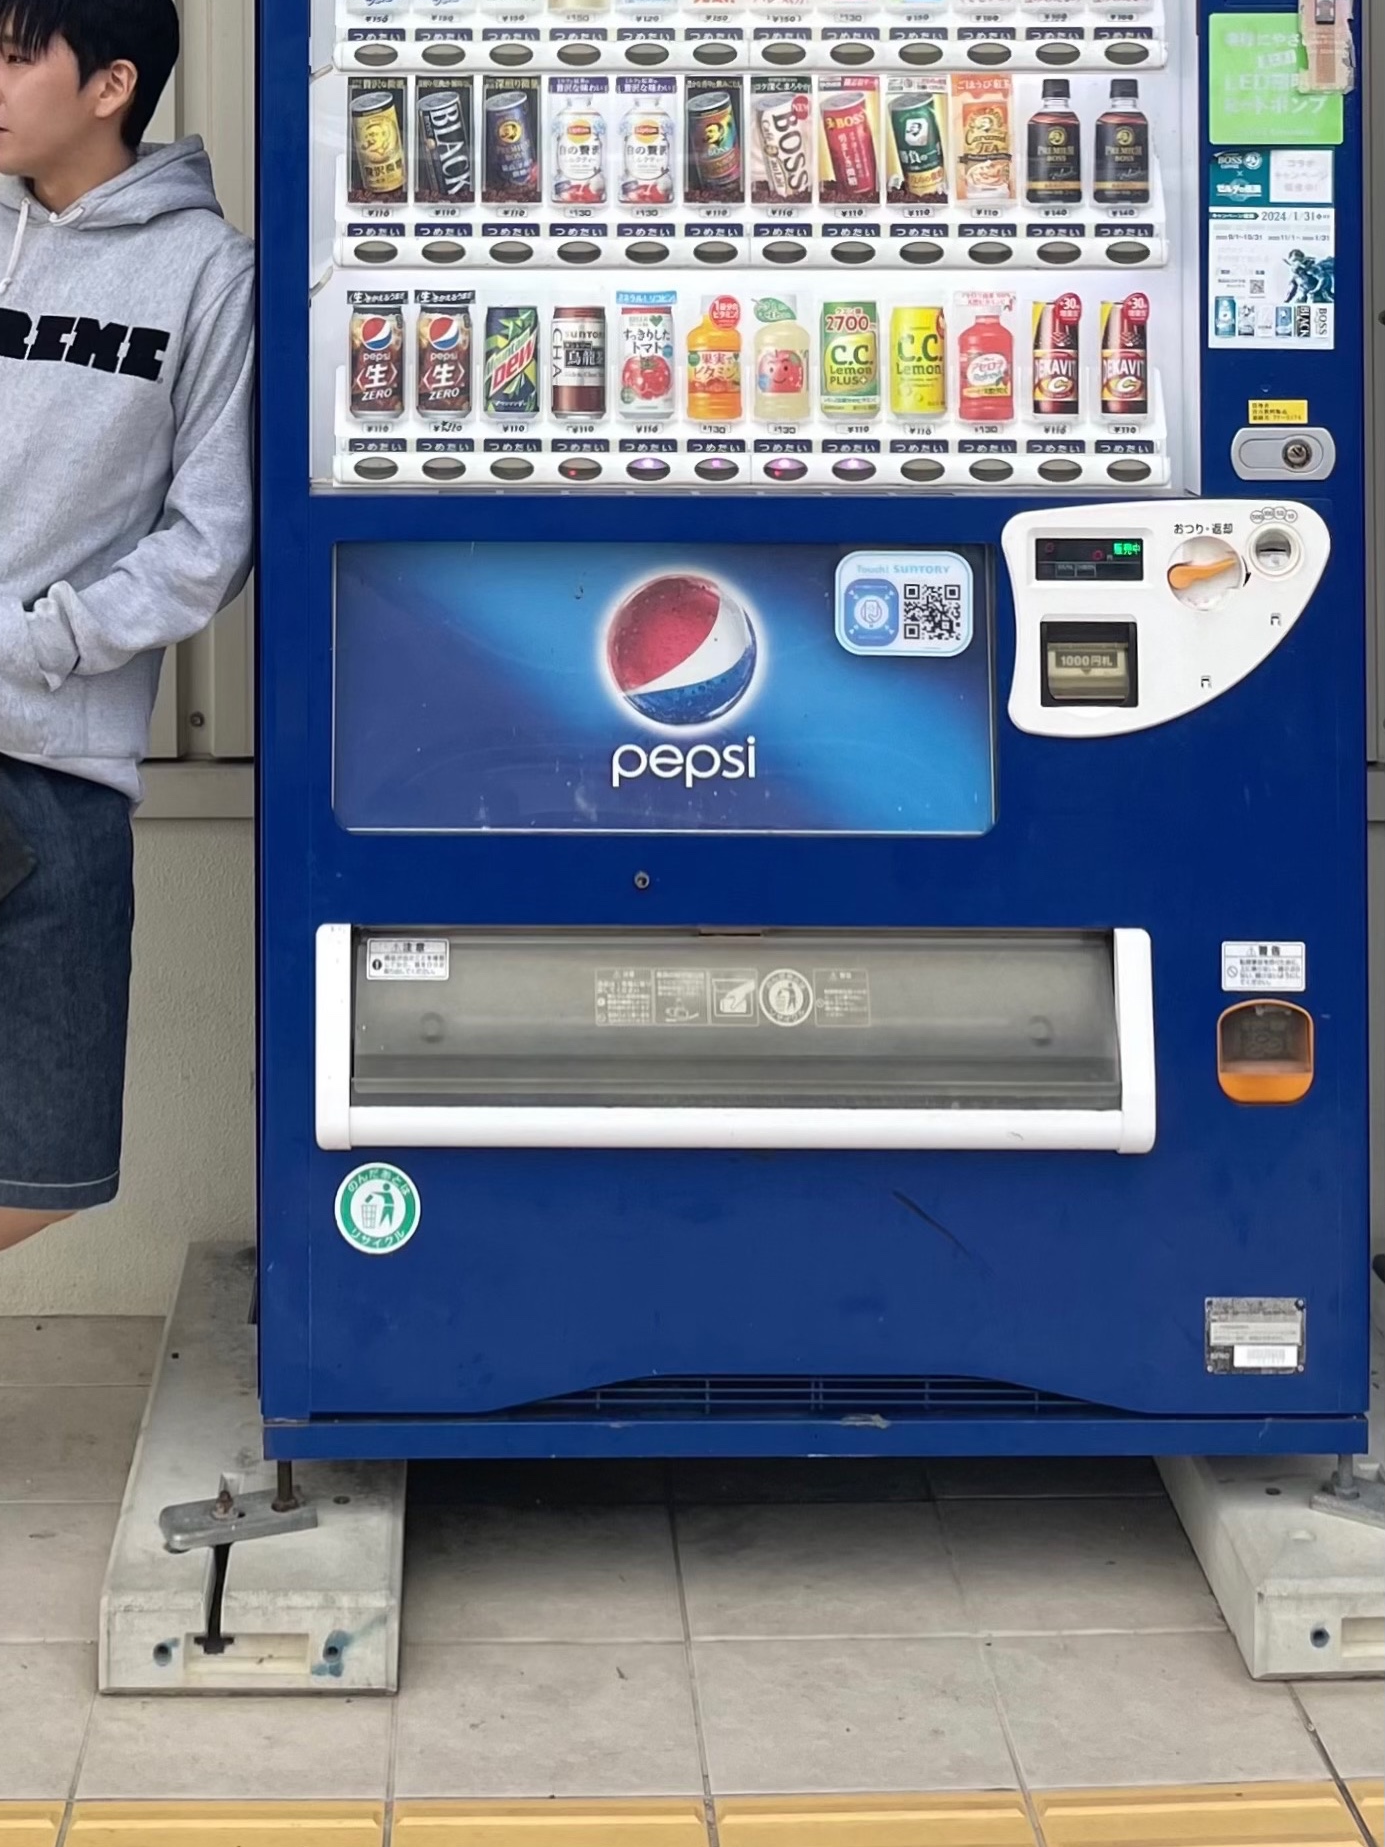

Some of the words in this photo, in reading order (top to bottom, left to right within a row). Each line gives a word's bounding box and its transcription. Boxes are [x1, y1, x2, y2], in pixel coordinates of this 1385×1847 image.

[836, 114, 865, 130] BOSS
[429, 104, 472, 195] BLACK
[772, 112, 809, 190] BOSS
[352, 227, 401, 236] つめたい
[420, 227, 468, 236] つめたい
[487, 227, 535, 236] つめたい
[554, 227, 602, 236] つめたい
[622, 227, 670, 236] つめたい
[690, 227, 738, 236] つめたい
[758, 227, 807, 236] つめたい
[827, 227, 876, 236] つめたい
[895, 227, 944, 236] つめたい
[964, 227, 1012, 236] つめたい
[1031, 227, 1081, 236] つめたい
[1100, 227, 1149, 236] つめたい
[826, 316, 869, 331] 2700
[1319, 308, 1328, 336] BOSS
[623, 329, 671, 341] すっきりした
[632, 342, 662, 354] トマト
[898, 334, 943, 362] C.C.
[831, 344, 874, 366] C.C.
[830, 365, 872, 374] Lemon
[896, 362, 941, 374] Lemon
[830, 376, 860, 385] PLUS
[362, 388, 392, 401] ZERO
[429, 388, 460, 401] ZERO
[354, 442, 403, 452] つめたい
[420, 442, 470, 452] つめたい
[488, 442, 537, 452] つめたい
[556, 442, 604, 452] つめたい
[624, 442, 672, 452] つめたい
[692, 442, 740, 452] つめたい
[758, 442, 808, 452] つめたい
[826, 443, 876, 453] つめたい
[895, 443, 944, 453] つめたい
[963, 443, 1012, 453] つめたい
[1032, 443, 1081, 453] つめたい
[1100, 443, 1149, 453] つめたい
[1174, 523, 1233, 534] おつり・返却
[857, 564, 890, 574] Touch!
[893, 564, 951, 574] SUNTORY
[1061, 654, 1113, 666] 1000円札
[612, 736, 756, 788] pepsi
[351, 1228, 405, 1248] リサイクル
